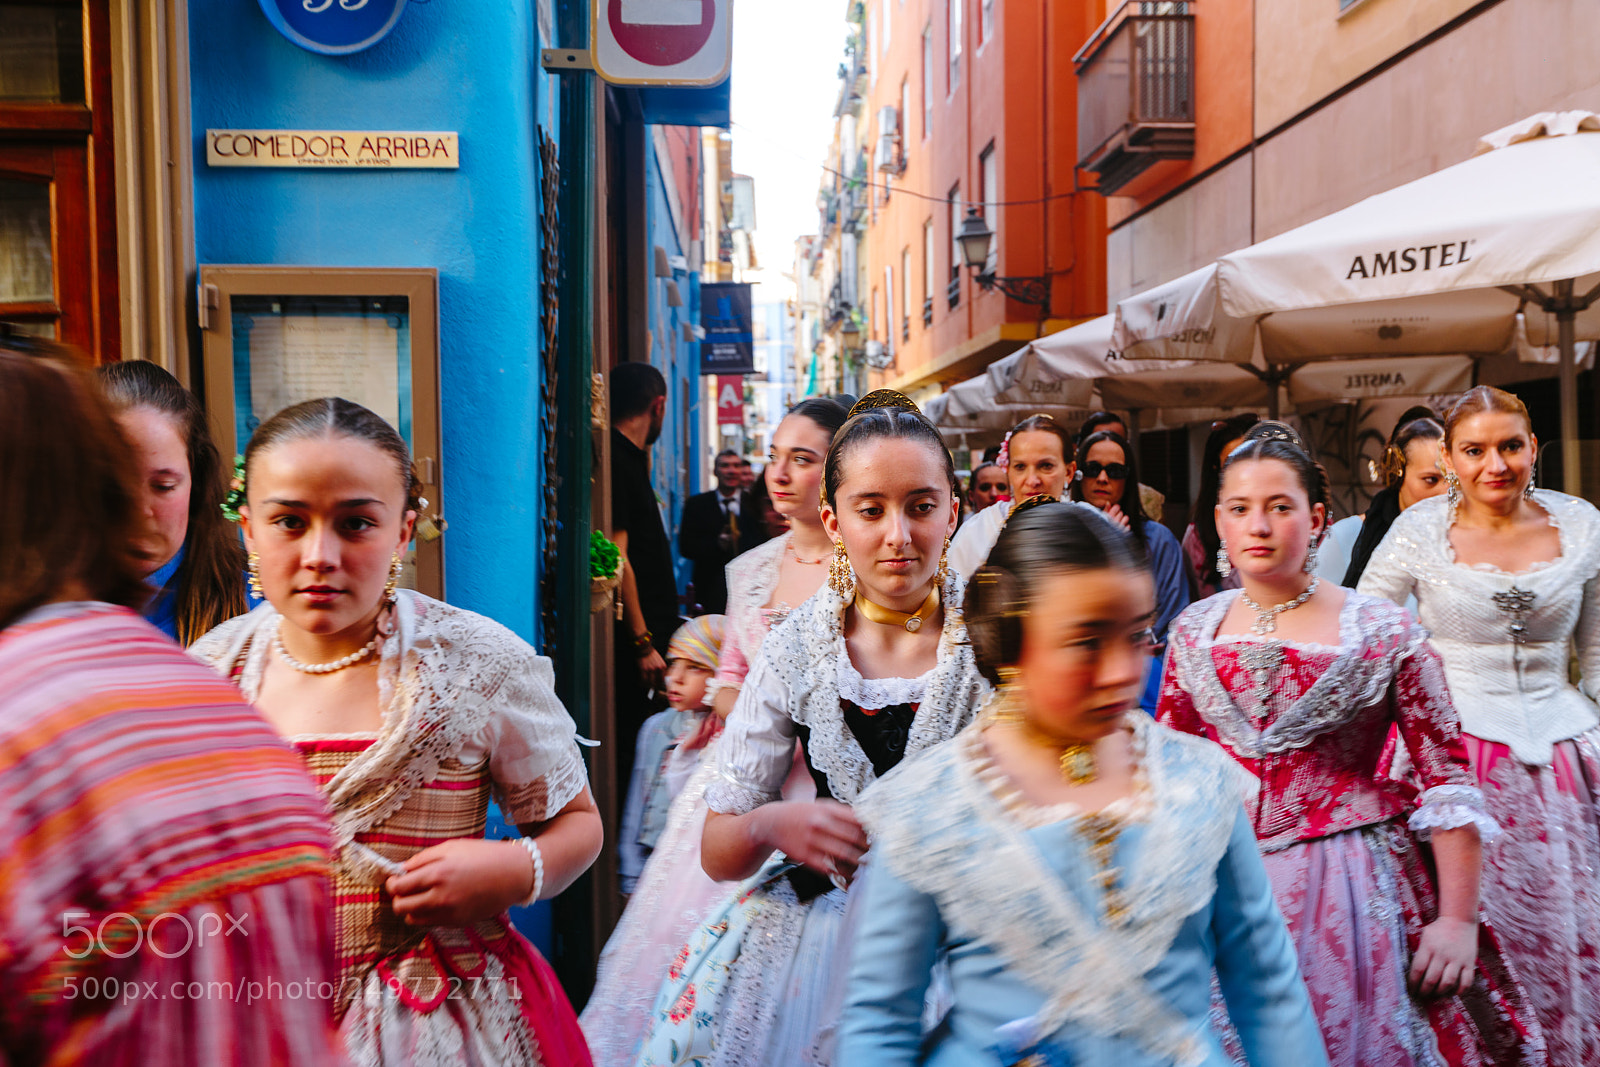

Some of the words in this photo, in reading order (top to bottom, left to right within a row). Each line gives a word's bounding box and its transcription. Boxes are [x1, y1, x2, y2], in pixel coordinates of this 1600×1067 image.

[213, 133, 349, 159] COMEDOR
[356, 136, 450, 159] ARRIBA
[1345, 240, 1472, 280] AMSTEL
